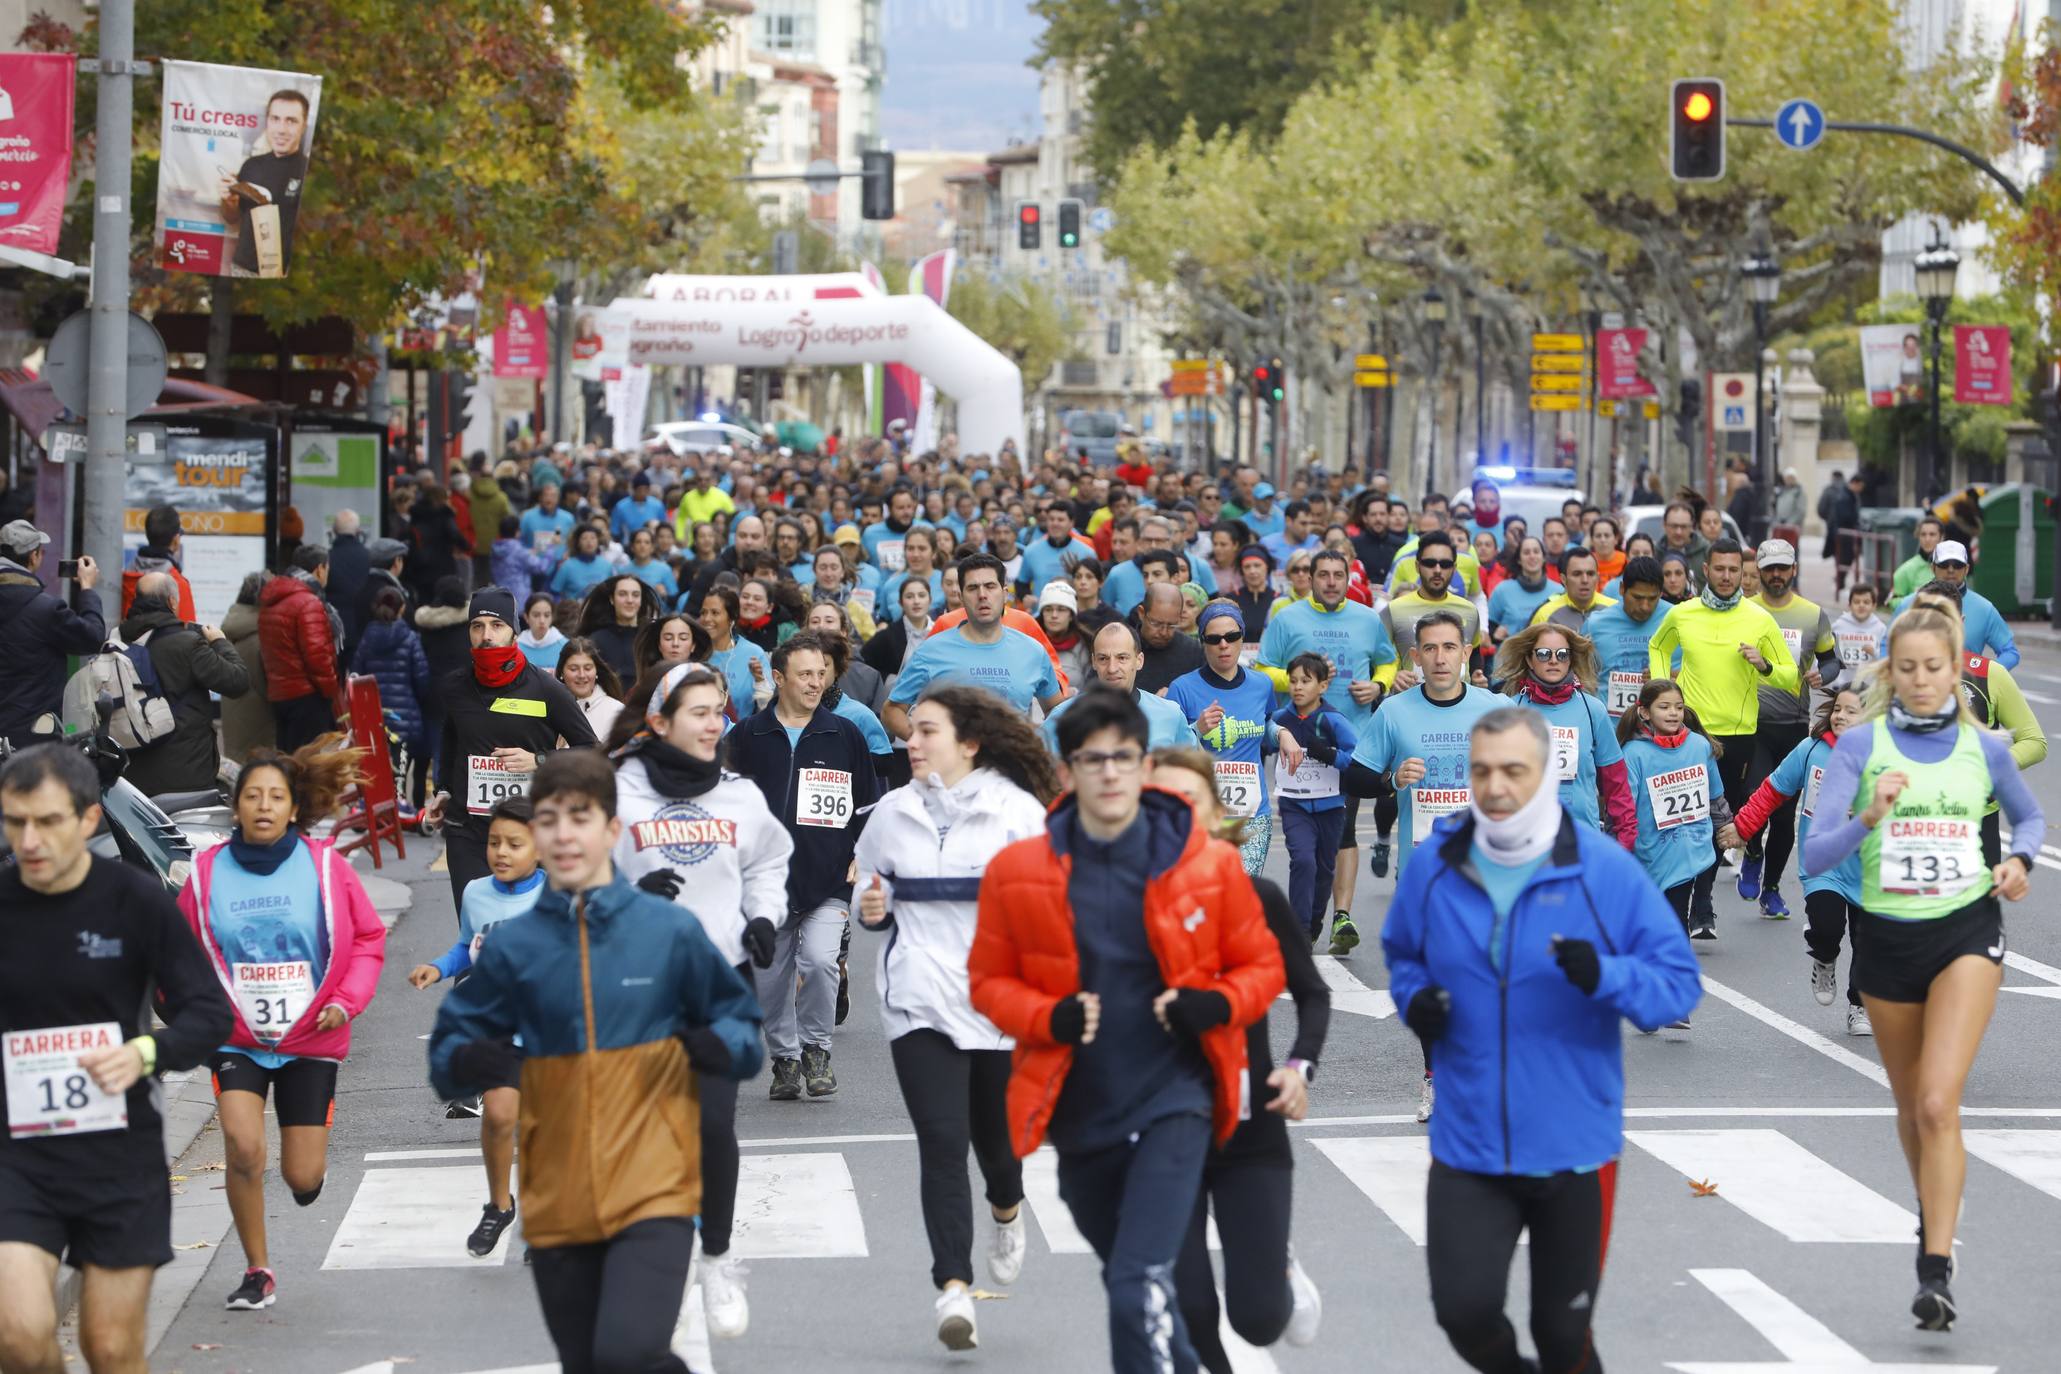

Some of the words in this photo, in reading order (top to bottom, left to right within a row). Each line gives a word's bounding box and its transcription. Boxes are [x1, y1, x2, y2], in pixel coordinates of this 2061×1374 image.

[170, 101, 195, 121] Tú
[201, 110, 258, 129] creas
[171, 124, 212, 136] COMERCIO
[213, 129, 240, 138] LOCAL
[186, 450, 247, 467] mendi
[173, 460, 253, 488] tour
[1313, 629, 1350, 640] CARRERA
[969, 666, 1010, 678] CARRERA
[805, 770, 849, 785] CARRERA
[1215, 762, 1257, 775] ARRERA
[1653, 766, 1704, 788] CARRERA
[810, 793, 847, 817] 396
[1417, 789, 1468, 804] CARRER
[1664, 789, 1705, 816] 221
[637, 819, 732, 848] MARISTAS
[1891, 821, 1969, 838] CARRERA
[1901, 855, 1963, 882] 133
[229, 894, 293, 914] CARRERA
[240, 964, 307, 983] CARRERA
[255, 998, 292, 1025] 31
[10, 1028, 111, 1058] CARRERA
[38, 1074, 90, 1113] 18
